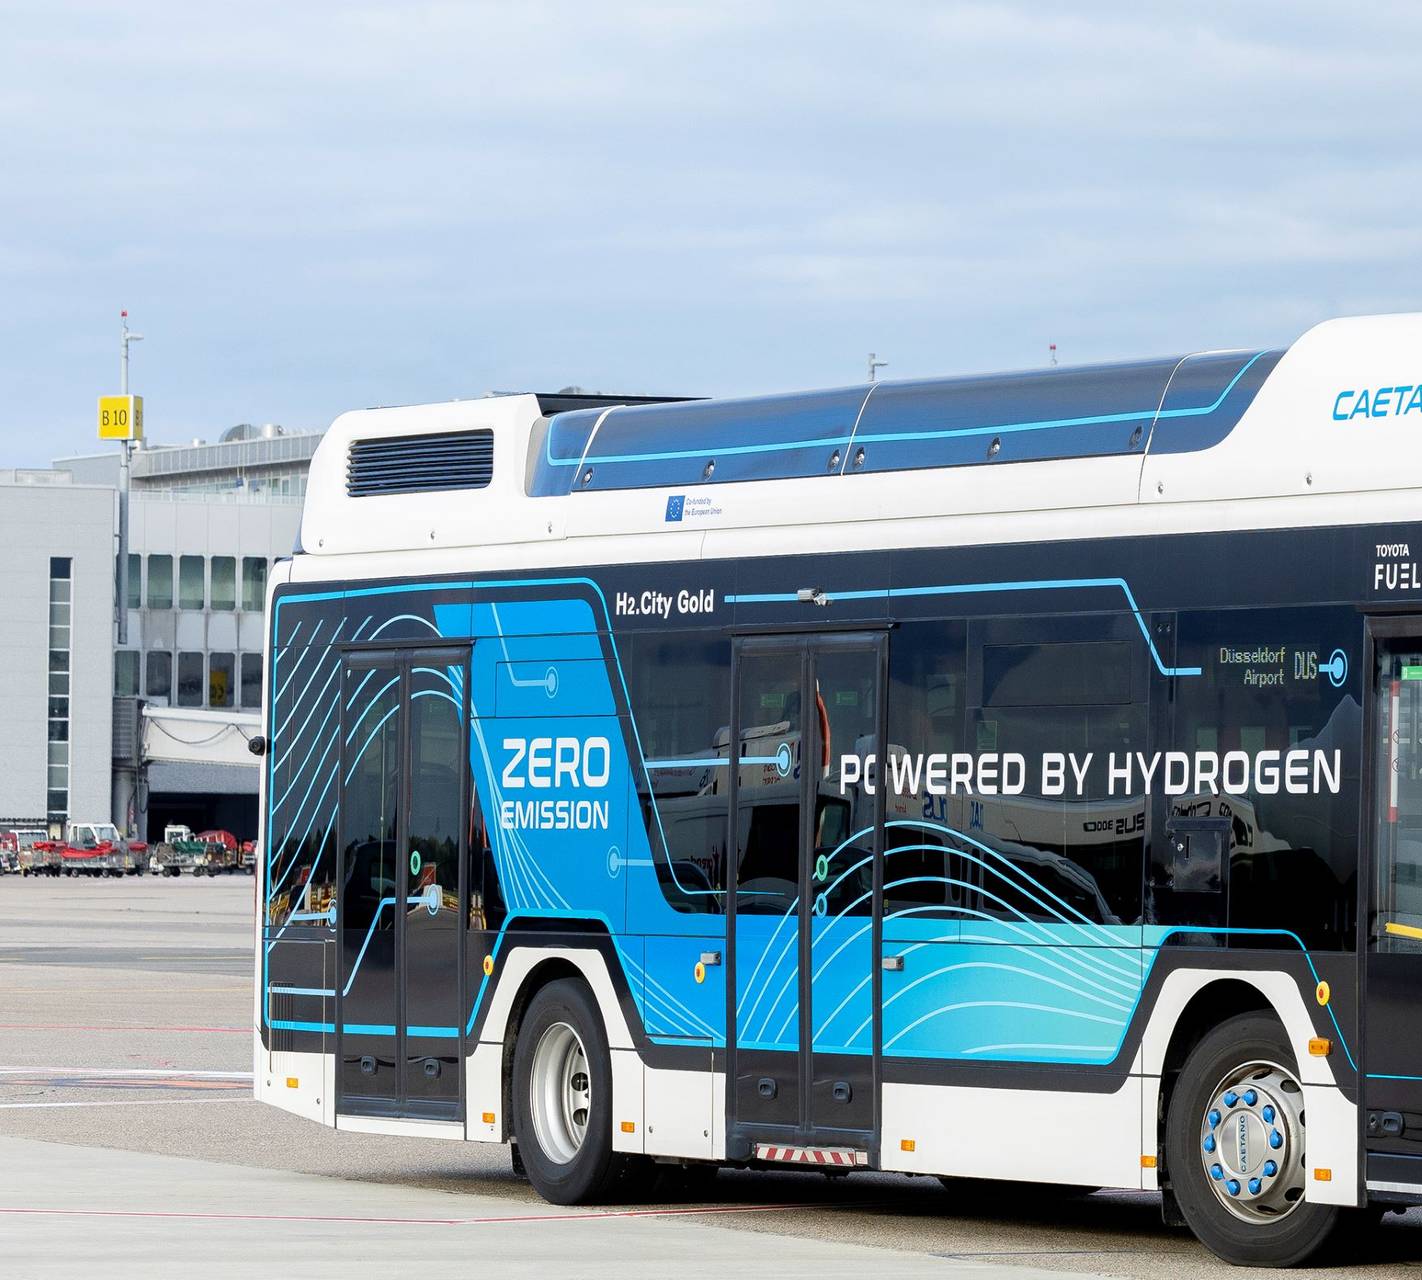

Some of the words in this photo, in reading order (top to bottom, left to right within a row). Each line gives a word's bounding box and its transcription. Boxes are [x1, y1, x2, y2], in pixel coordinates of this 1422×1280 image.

[102, 410, 110, 426] B
[113, 409, 127, 426] 10
[1376, 544, 1410, 557] TOYOTA
[616, 591, 673, 619] H2.City
[678, 588, 714, 614] Gold
[1220, 647, 1286, 664] Düsseldorf
[1294, 651, 1317, 680] DUS
[1244, 669, 1284, 688] Airport
[502, 736, 611, 788] ZERO
[1041, 752, 1094, 796] BY
[1108, 749, 1342, 796] HYDROGEN
[501, 800, 609, 829] EMISSION
